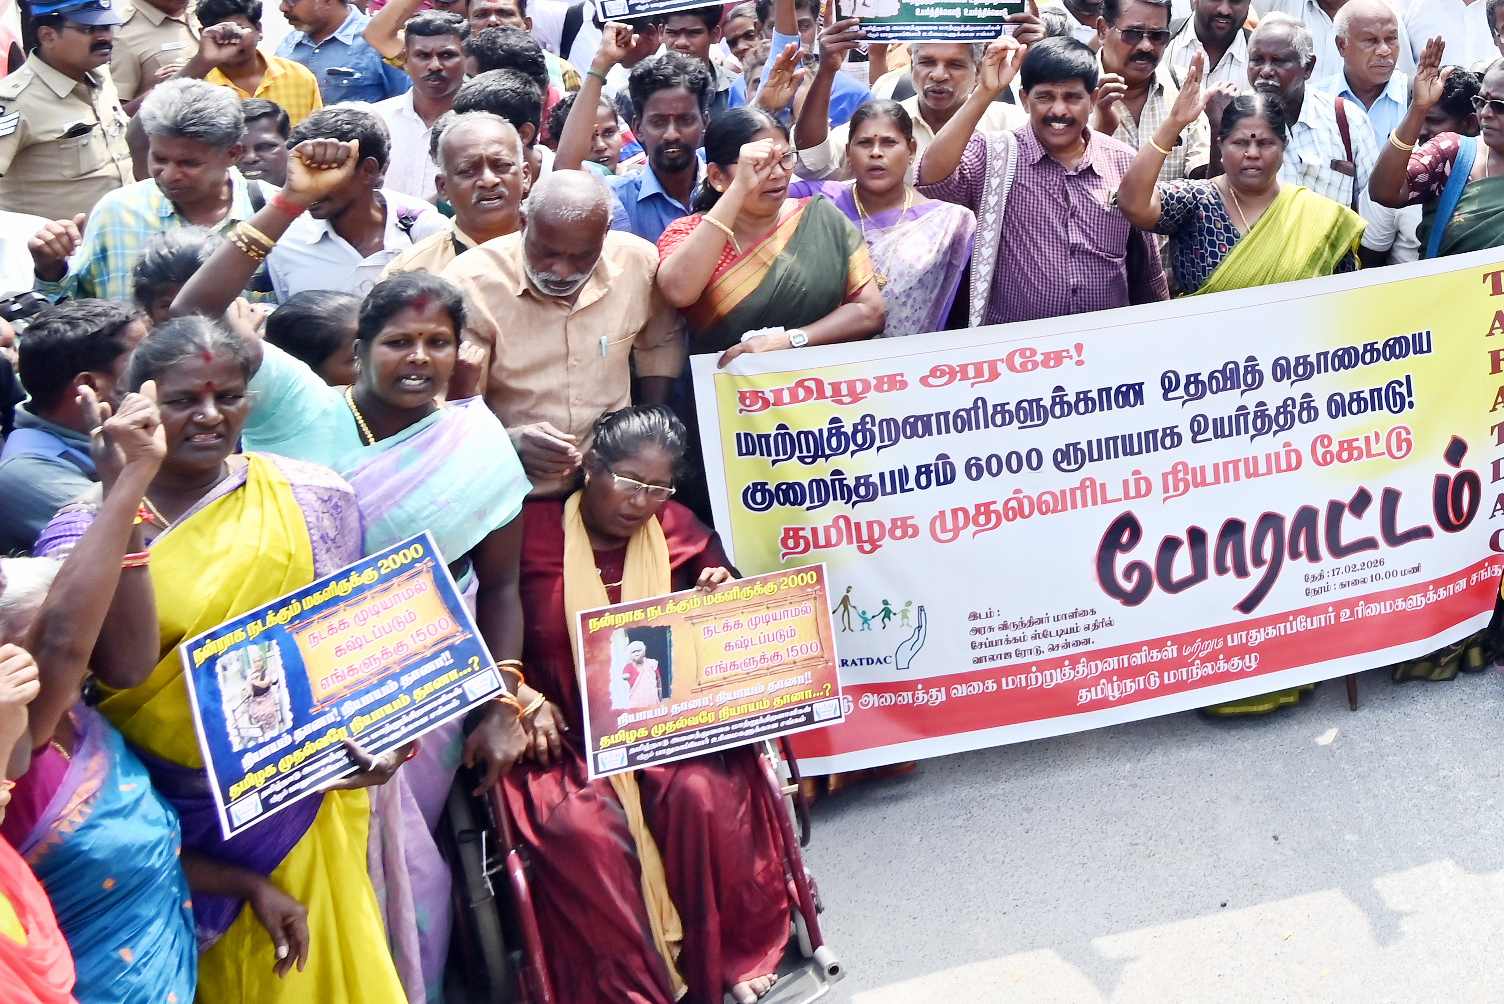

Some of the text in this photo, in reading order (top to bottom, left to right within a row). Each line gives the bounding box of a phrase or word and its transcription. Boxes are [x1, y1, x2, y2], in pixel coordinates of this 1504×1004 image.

[735, 329, 1433, 467] மாற்றுத்திறனாளிகளுக்கான உதவித் தொகையை
[738, 342, 1085, 414] தமிழக அரசே!
[742, 374, 1414, 512] குறைந்தபட்சம் 6000 ரூபாயாக உயர்த்திக் கொடு!
[779, 424, 1413, 560] தமிழக முதல்வரிடம் நியாயம் கேட்டு
[1095, 434, 1482, 615] போராட்டம்
[1304, 569, 1324, 584] தேதி
[1332, 558, 1385, 577] 17.02.2026
[1305, 582, 1331, 597] நேரம்
[1339, 577, 1368, 589] காலை
[1370, 569, 1398, 583] 10.00
[1400, 563, 1422, 576] மணி
[193, 544, 424, 666] நன்றாக நடக்கும் மகளிருக்கு 2000
[307, 578, 429, 646] நடக்க முடியாமல்
[589, 570, 817, 633] நன்றாக நடக்கும் மகளிருக்கு 2000
[702, 602, 813, 639] நடக்க முடியாமல்
[968, 608, 994, 621] இடம்
[969, 607, 1096, 636] அரசு விருந்தினர் மாளிகை
[318, 616, 449, 693] எங்களுக்கு 1500
[333, 608, 417, 660] கஷ்டப்படும்
[703, 640, 819, 679] எங்களுக்கு 1500
[723, 626, 797, 655] கஷ்டப்படும்
[859, 685, 946, 710] அனைத்து
[950, 679, 997, 700] வகை
[1001, 640, 1178, 695] மாற்றுத்திறனாளிகள்
[1181, 636, 1224, 663] மற்றும்
[1226, 605, 1336, 647] பாதுகாப்போர்
[1339, 576, 1468, 622] உரிமைகளுக்கான
[1469, 561, 1504, 589] சங்க
[971, 617, 1115, 650] சேப்பாக்கம் ஸ்டேடியம் எதிரில்
[972, 638, 1095, 665] வாலாஜ ரோடு, சென்னை.
[617, 671, 812, 727] நியாயம் தானா! நியாயம் தானா!!
[1077, 652, 1260, 706] தமிழ்நாடு மாநிலக்குழு
[601, 727, 649, 748] தமிழக
[651, 710, 717, 738] முதல்வரே
[719, 697, 772, 721] நியாயம்
[773, 683, 832, 709] தானா...?
[229, 764, 278, 800] தமிழக
[350, 694, 411, 734] நியாயம்
